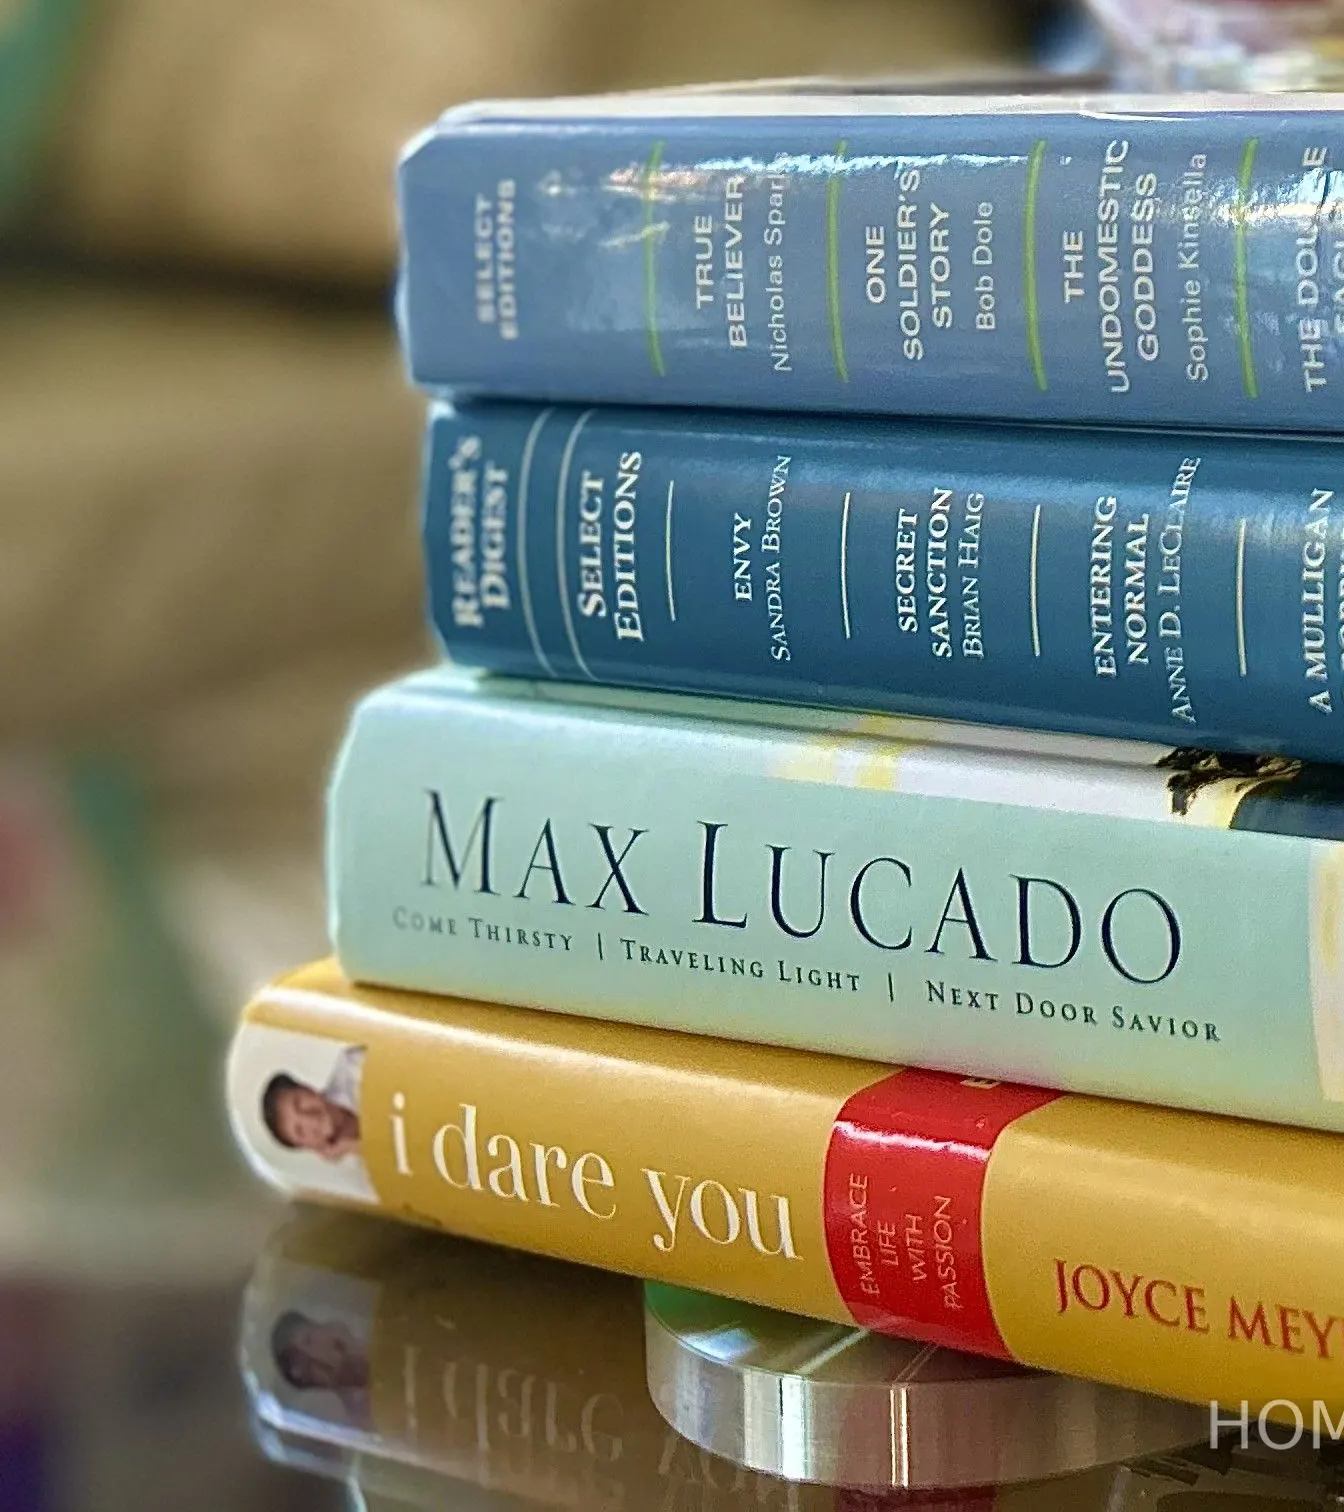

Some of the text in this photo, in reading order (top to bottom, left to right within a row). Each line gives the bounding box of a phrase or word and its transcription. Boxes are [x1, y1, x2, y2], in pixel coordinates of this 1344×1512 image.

[475, 192, 496, 323] SELECT
[496, 178, 518, 340] EDITIONS
[694, 214, 714, 309] TRUE
[725, 173, 748, 348] BELIEVER
[764, 253, 793, 372] Nicholas
[866, 225, 886, 304] ONE
[896, 168, 924, 361] SOLDIER'S
[930, 202, 953, 330] STORY
[972, 200, 997, 330] Bob Dole
[1062, 229, 1086, 304] THE
[1098, 138, 1130, 393] UNDOMESTIC
[1131, 171, 1160, 362] GODDESS
[1178, 152, 1210, 383] Sophie Kinsella
[1296, 144, 1329, 393] THE DOUE
[447, 435, 484, 629] READER'S
[480, 460, 512, 610] DIGEST
[576, 470, 607, 619] SELECT
[612, 450, 645, 642] EDITIONS
[731, 512, 753, 603] ENVY
[760, 455, 793, 663] SANDRA BROWN
[895, 507, 920, 634] SECRET
[925, 486, 955, 660] SANCTION
[958, 491, 986, 660] BRIAN HAIG
[1090, 493, 1119, 677] ENTERING
[1123, 512, 1151, 666] NORMAL
[1301, 487, 1336, 714] A MULLIGAN
[1158, 603, 1183, 638] D.
[1166, 645, 1197, 724] ANNE
[420, 788, 1183, 985] MAX LUCADO
[392, 905, 1222, 1043] COME THIRSTY TRAVELING LIGHT NEXT DOOR SAVIOR
[389, 1091, 805, 1261] i dare you
[848, 1172, 881, 1298] EMBRACE
[876, 1219, 899, 1267] LIFE
[904, 1213, 928, 1282] WITH
[933, 1194, 964, 1311] PASSION
[1055, 1258, 1209, 1334] JOYCE
